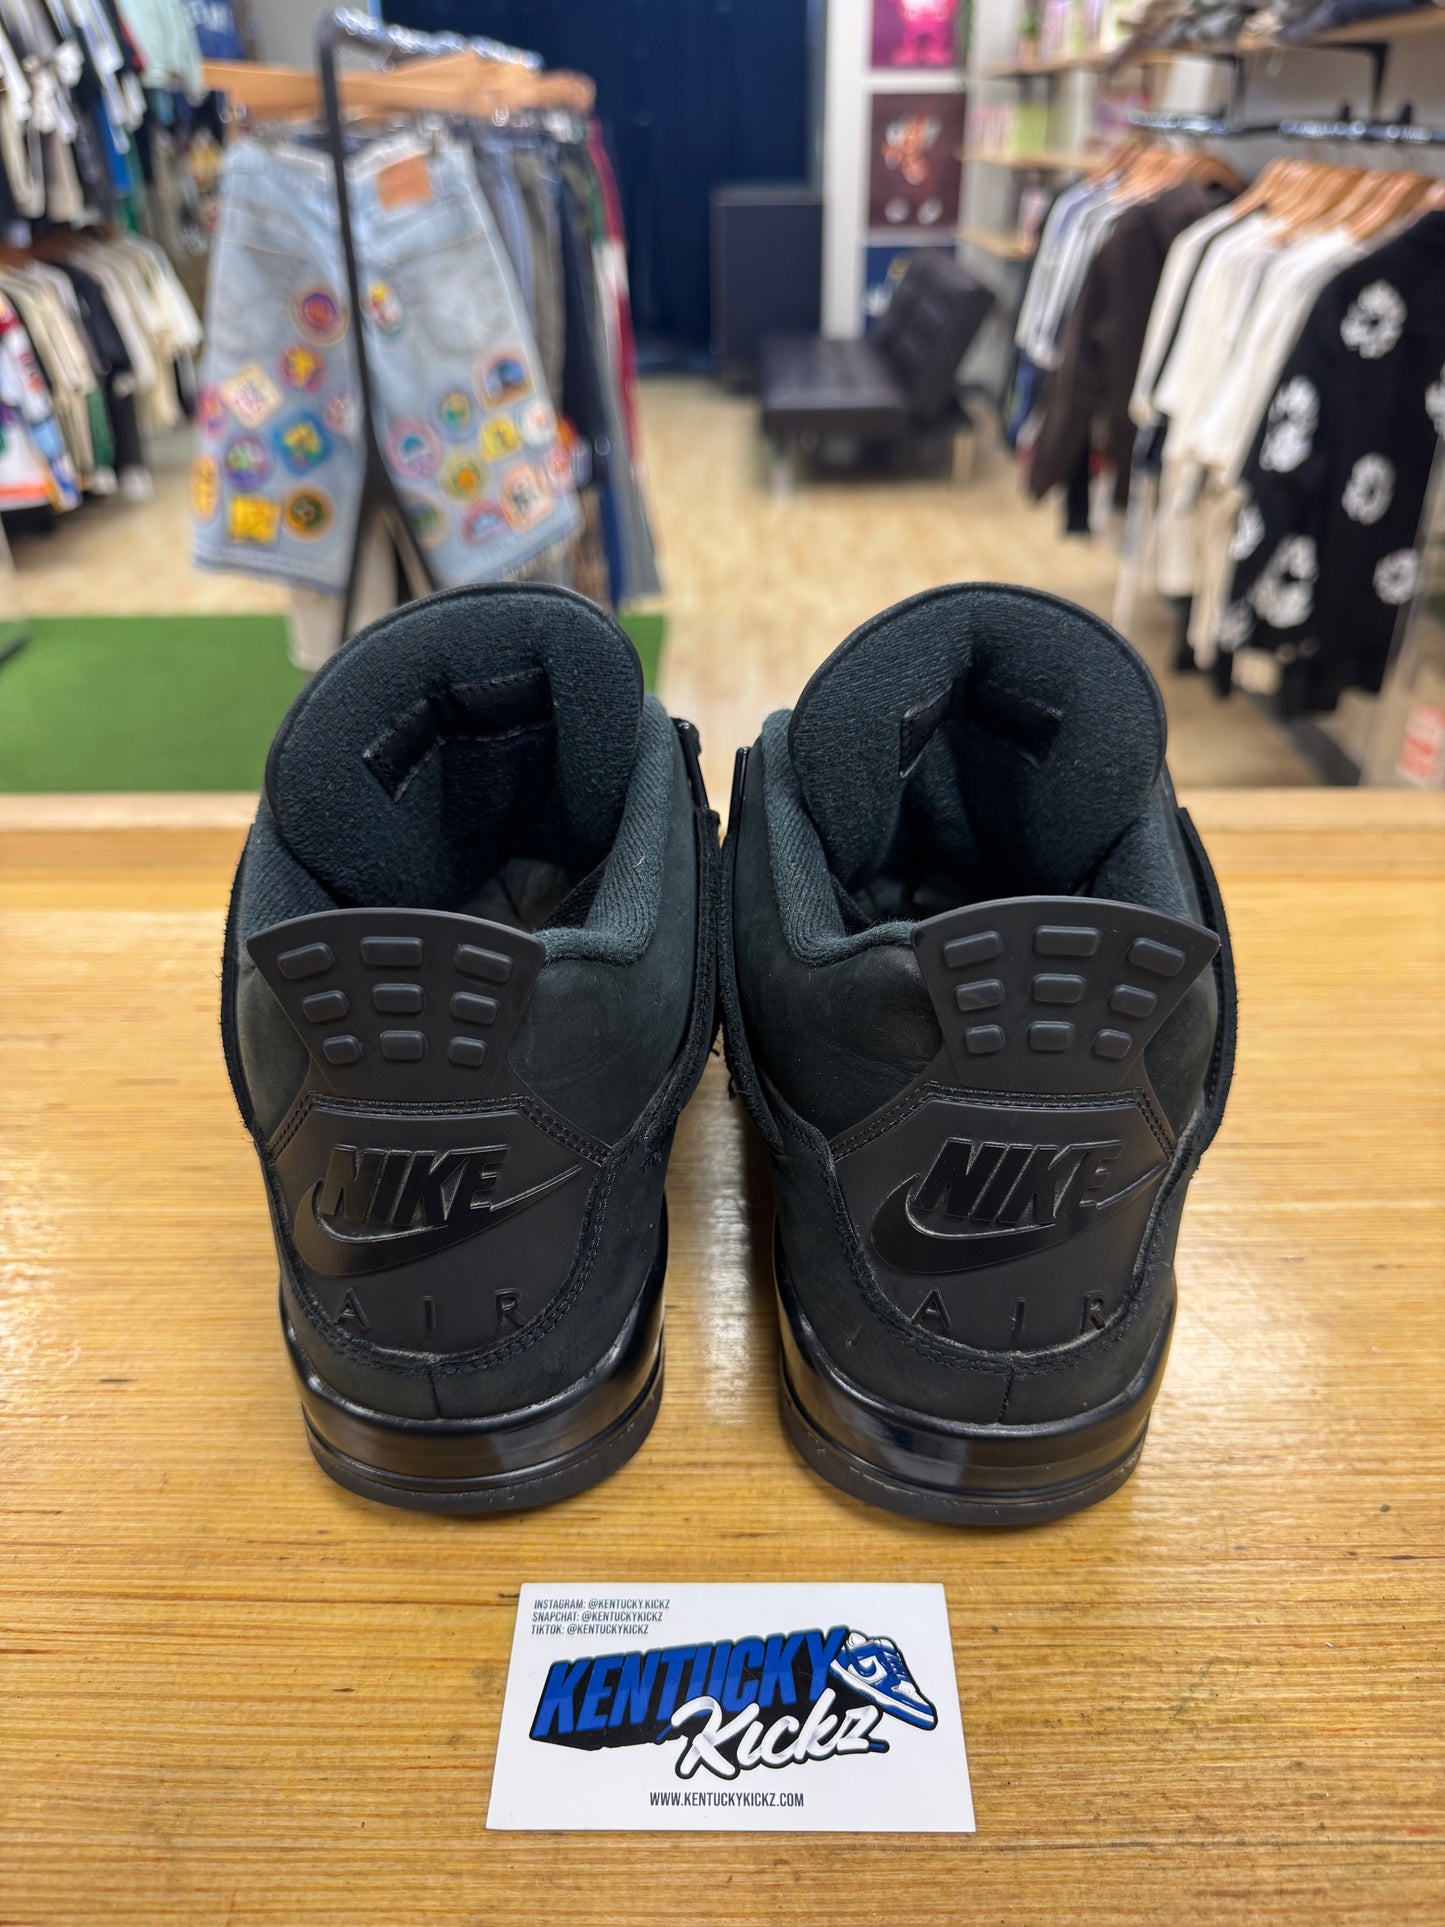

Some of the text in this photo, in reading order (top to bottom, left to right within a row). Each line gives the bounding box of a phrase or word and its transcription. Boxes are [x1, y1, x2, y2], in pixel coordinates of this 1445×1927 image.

[319, 1143, 509, 1228] NIKE
[909, 1136, 1124, 1228] NIKE
[333, 1287, 527, 1338] AIR
[911, 1286, 1107, 1342] AIR
[531, 1623, 649, 1635] TIKTOK: @KENTUCKYKICKZ
[532, 1610, 663, 1622] SNAPCHAT: @KENTUCKYKICKZ
[534, 1598, 670, 1609] INSTAGRAM: @KENTUCKY.KICKZ
[531, 1626, 850, 1742] KENTUCKY
[649, 1791, 805, 1807] WWW.KENTUCKYKICKZ.COM
